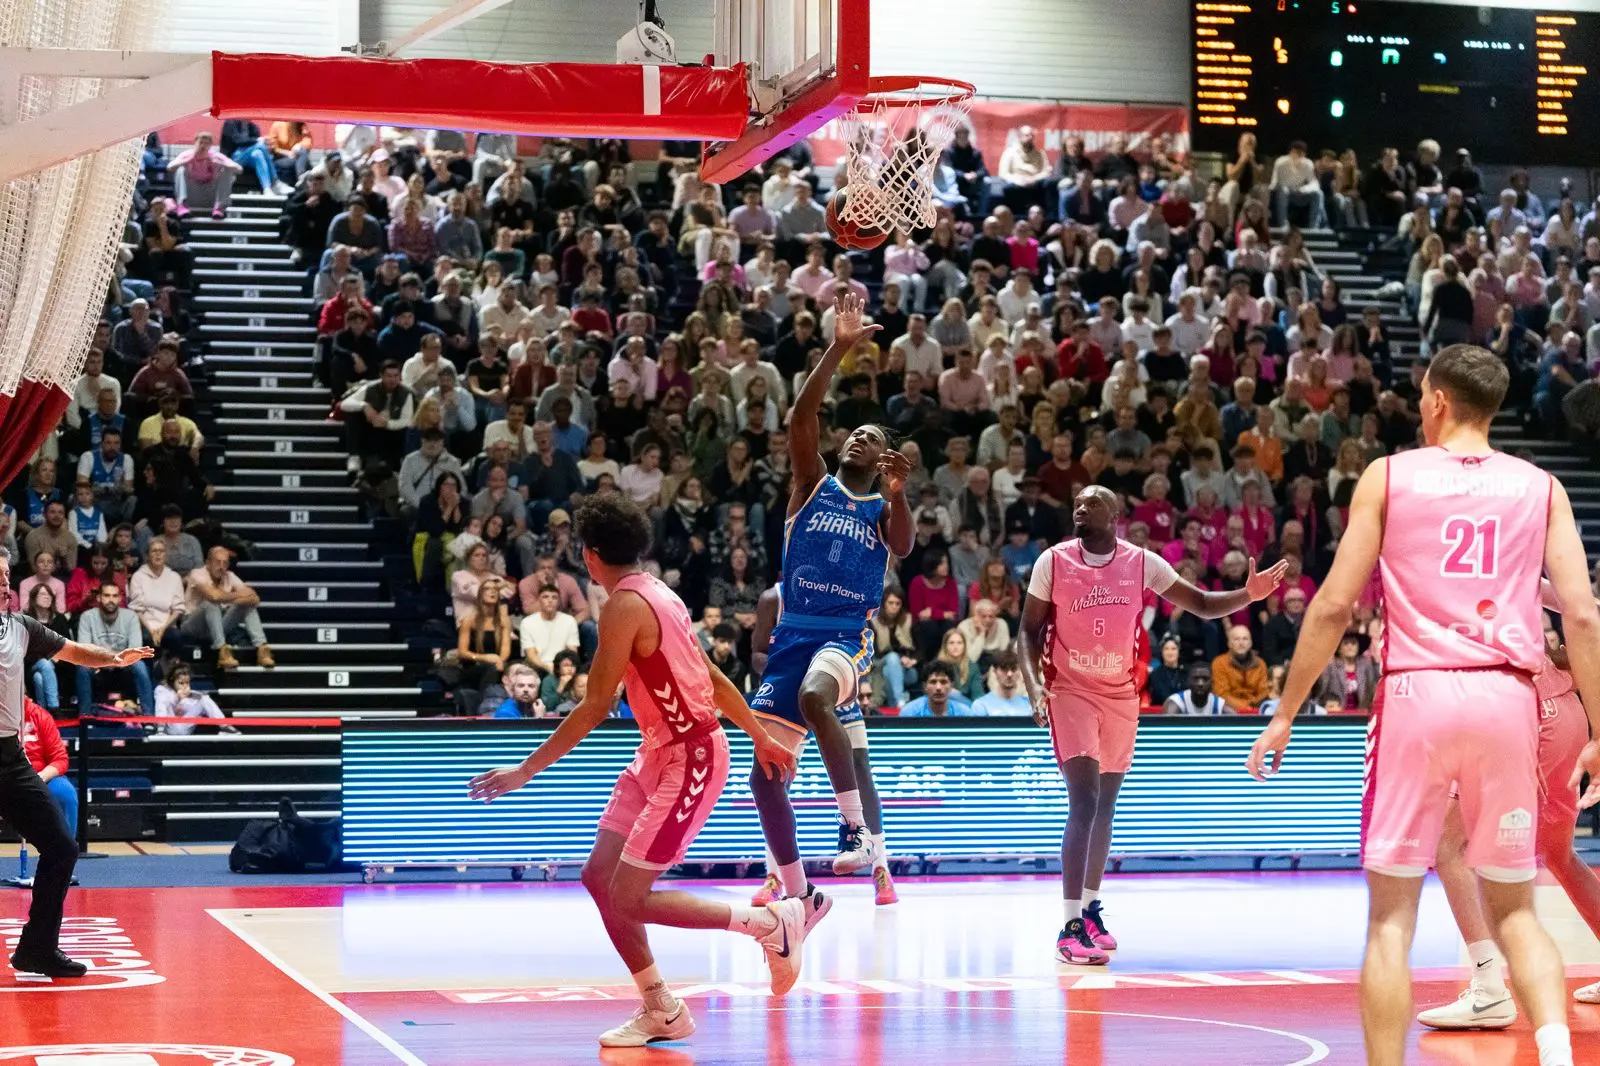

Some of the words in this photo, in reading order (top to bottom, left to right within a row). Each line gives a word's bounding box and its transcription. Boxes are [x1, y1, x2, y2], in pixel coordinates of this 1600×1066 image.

[806, 511, 878, 551] SHARKS
[1440, 514, 1501, 579] 21
[797, 576, 829, 593] Travel
[831, 583, 866, 602] Planet
[1088, 584, 1112, 601] Aix
[1068, 594, 1131, 615] Maurienne
[1093, 617, 1106, 638] 5
